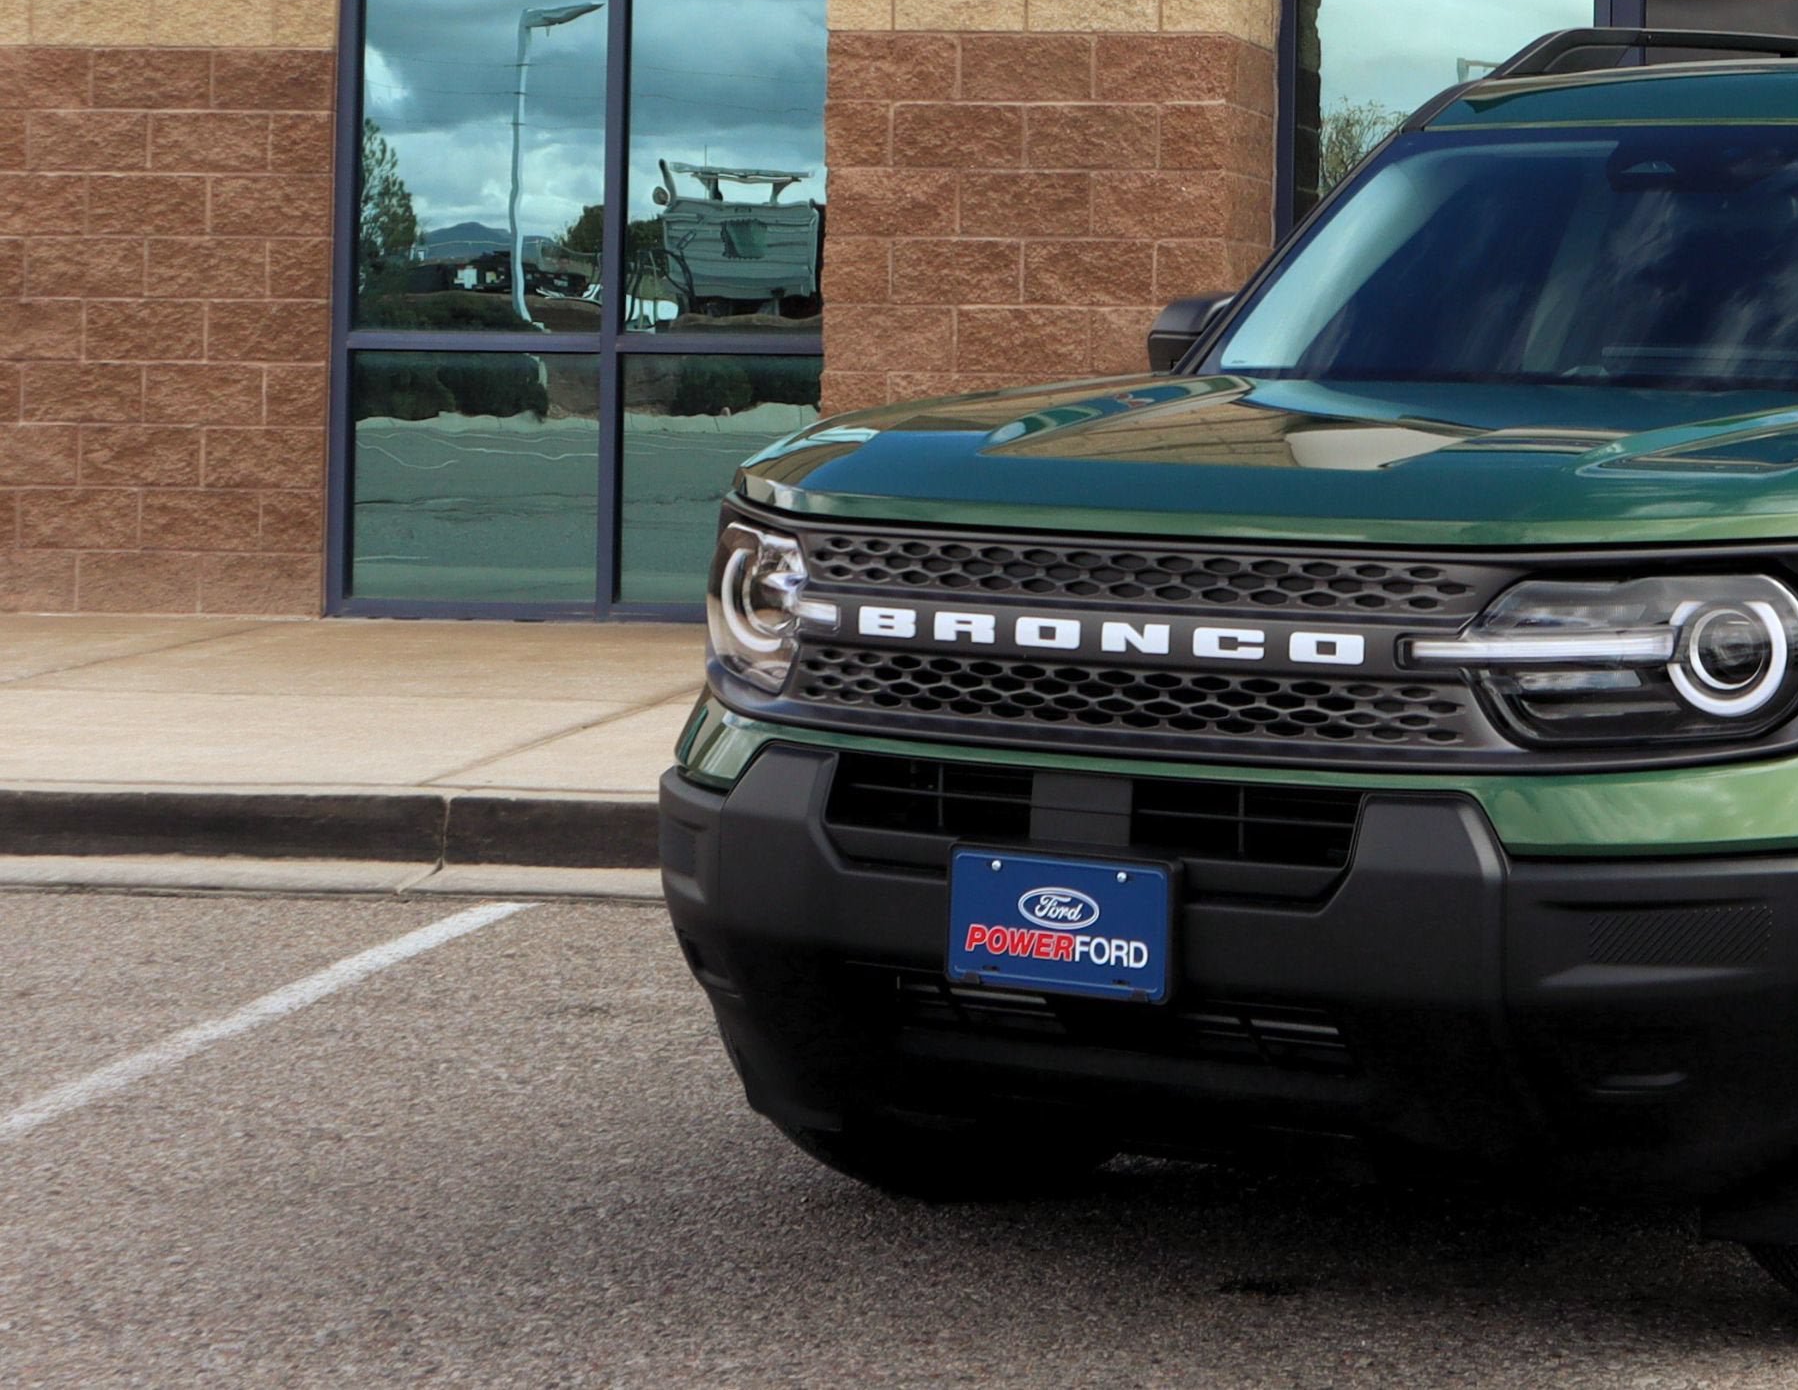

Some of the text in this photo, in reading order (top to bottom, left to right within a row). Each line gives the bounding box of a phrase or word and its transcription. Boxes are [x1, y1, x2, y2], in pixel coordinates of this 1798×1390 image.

[858, 605, 1365, 665] BRONCO
[1034, 894, 1085, 922] Ford
[964, 923, 1149, 970] POWERFORD
